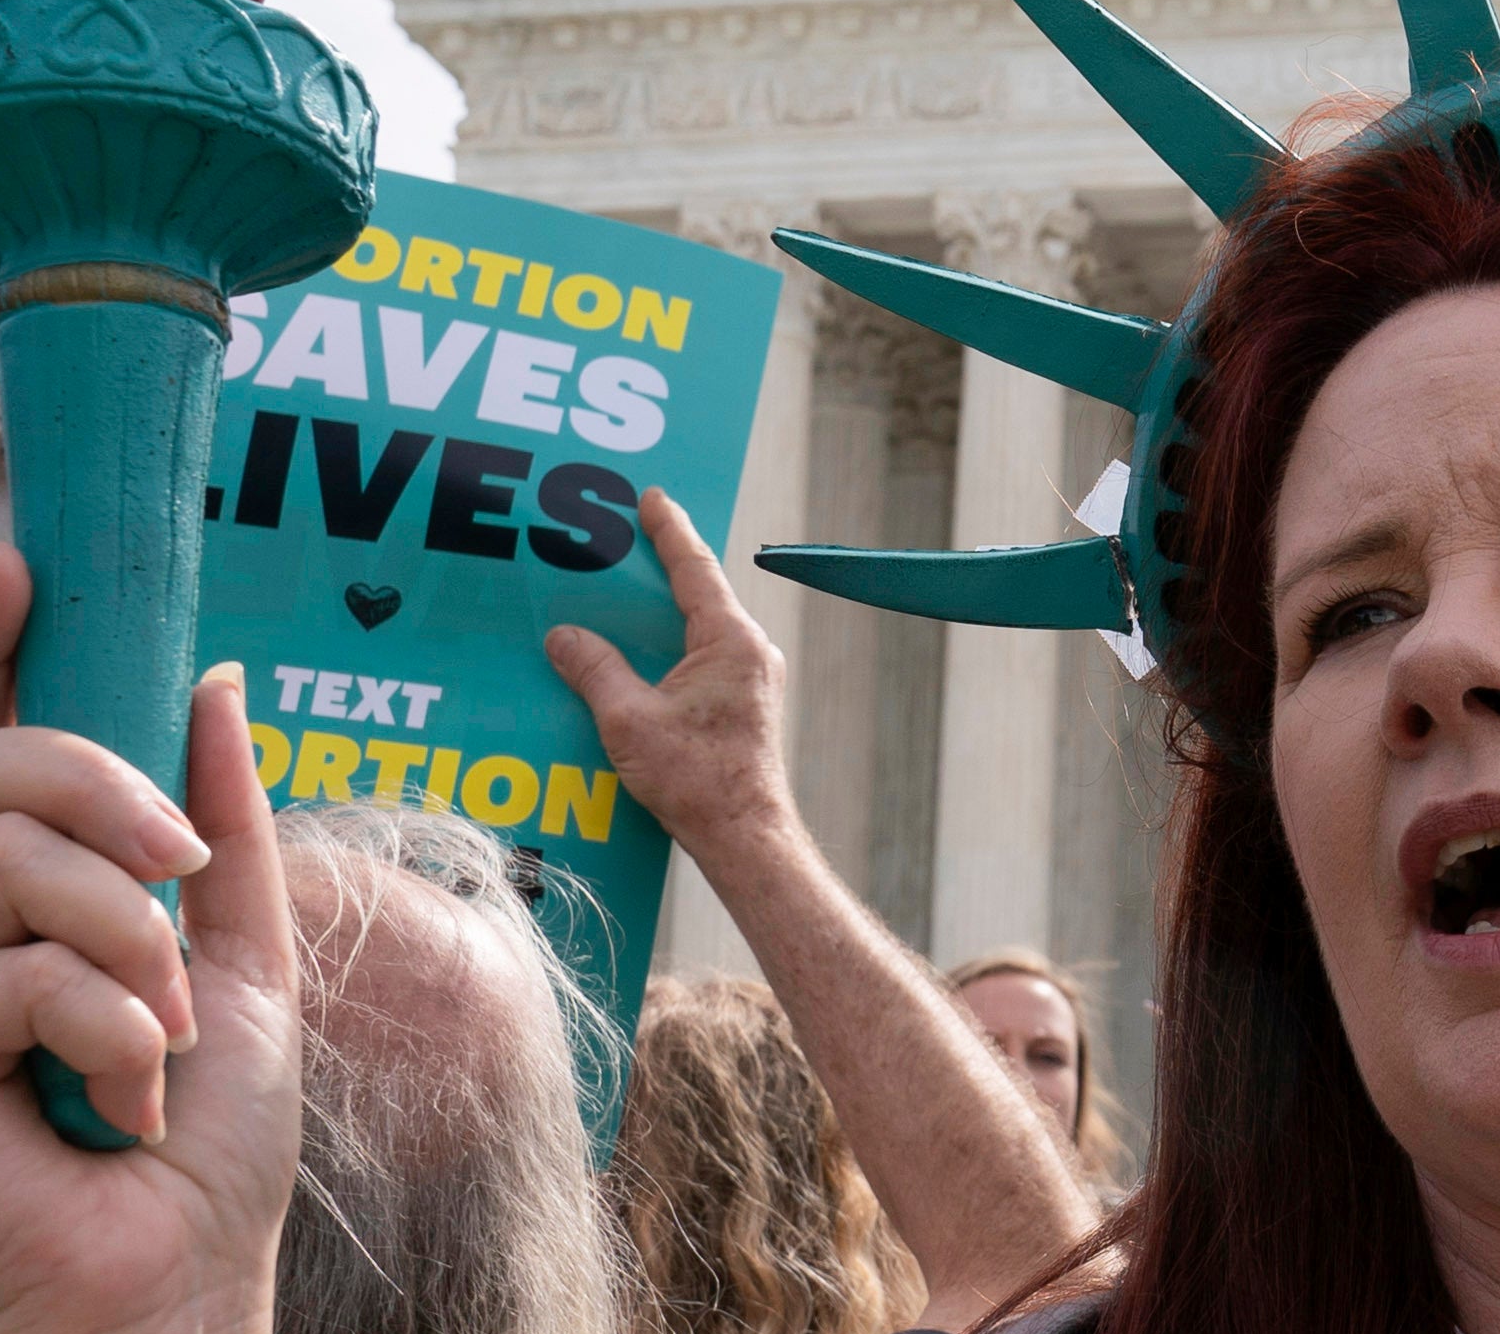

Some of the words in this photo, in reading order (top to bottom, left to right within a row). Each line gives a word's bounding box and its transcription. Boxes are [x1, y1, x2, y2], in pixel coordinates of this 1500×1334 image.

[220, 291, 669, 454] SAVES
[203, 410, 638, 573] IVES
[273, 664, 443, 729] TEXT
